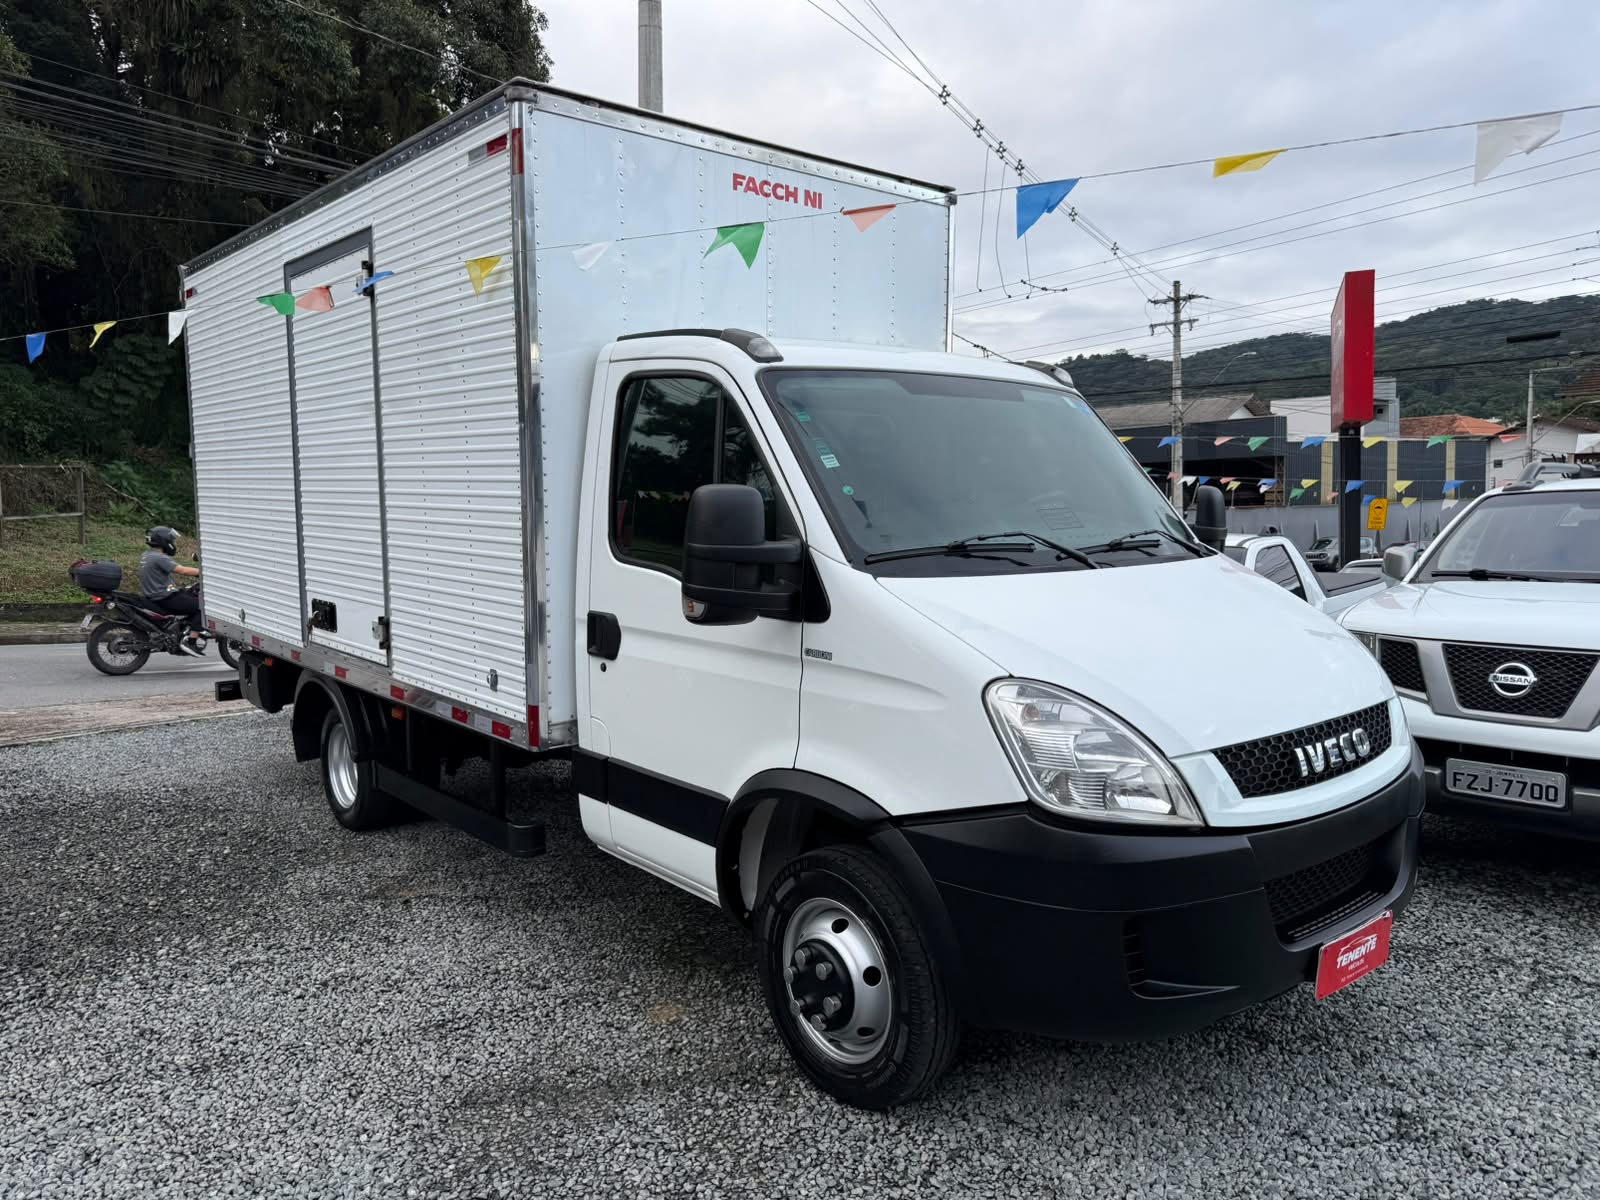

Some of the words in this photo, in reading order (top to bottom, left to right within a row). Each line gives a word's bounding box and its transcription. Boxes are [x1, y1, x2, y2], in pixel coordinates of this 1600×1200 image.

[1492, 674, 1532, 685] NISSAN
[1294, 728, 1371, 778] IVECO
[1336, 935, 1378, 969] TENENTE
